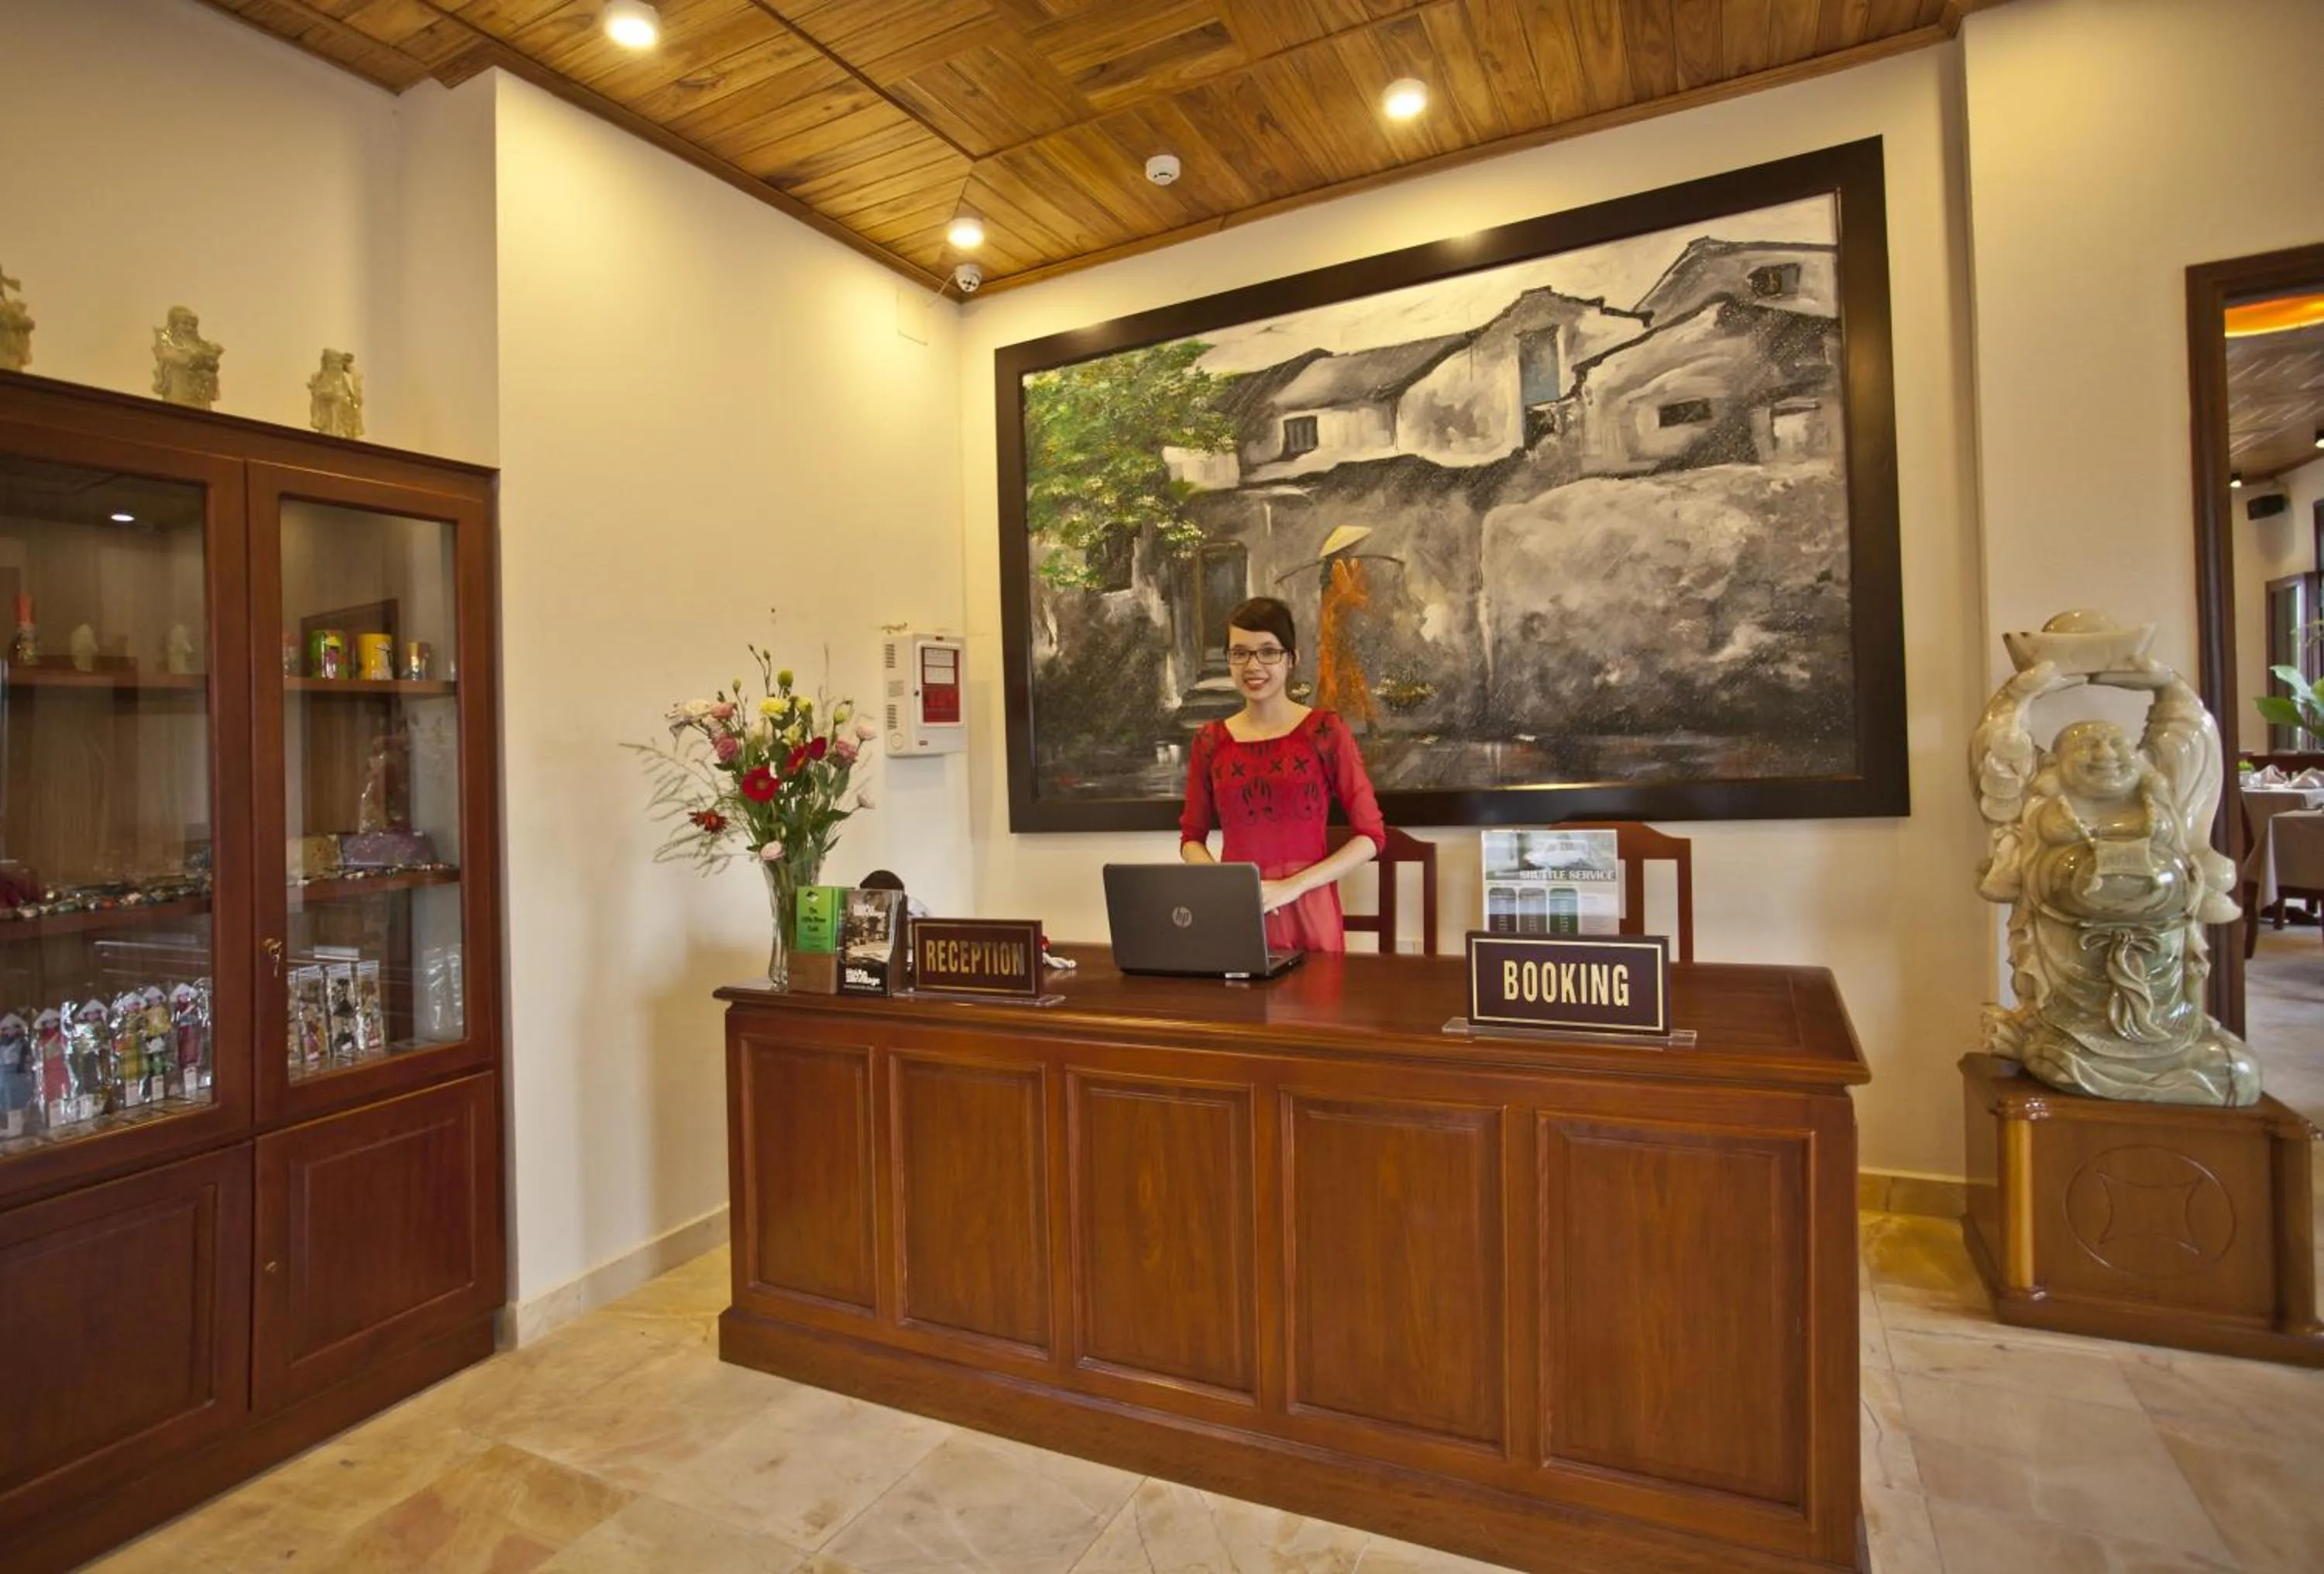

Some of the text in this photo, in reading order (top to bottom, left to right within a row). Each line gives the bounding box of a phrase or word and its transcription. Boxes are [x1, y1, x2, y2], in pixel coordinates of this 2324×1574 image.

[1519, 870, 1616, 881] SHUTTLE SERVICE
[1173, 906, 1191, 927] hp
[926, 939, 1025, 976] RECEPTION
[1503, 960, 1629, 1005] BOOKING
